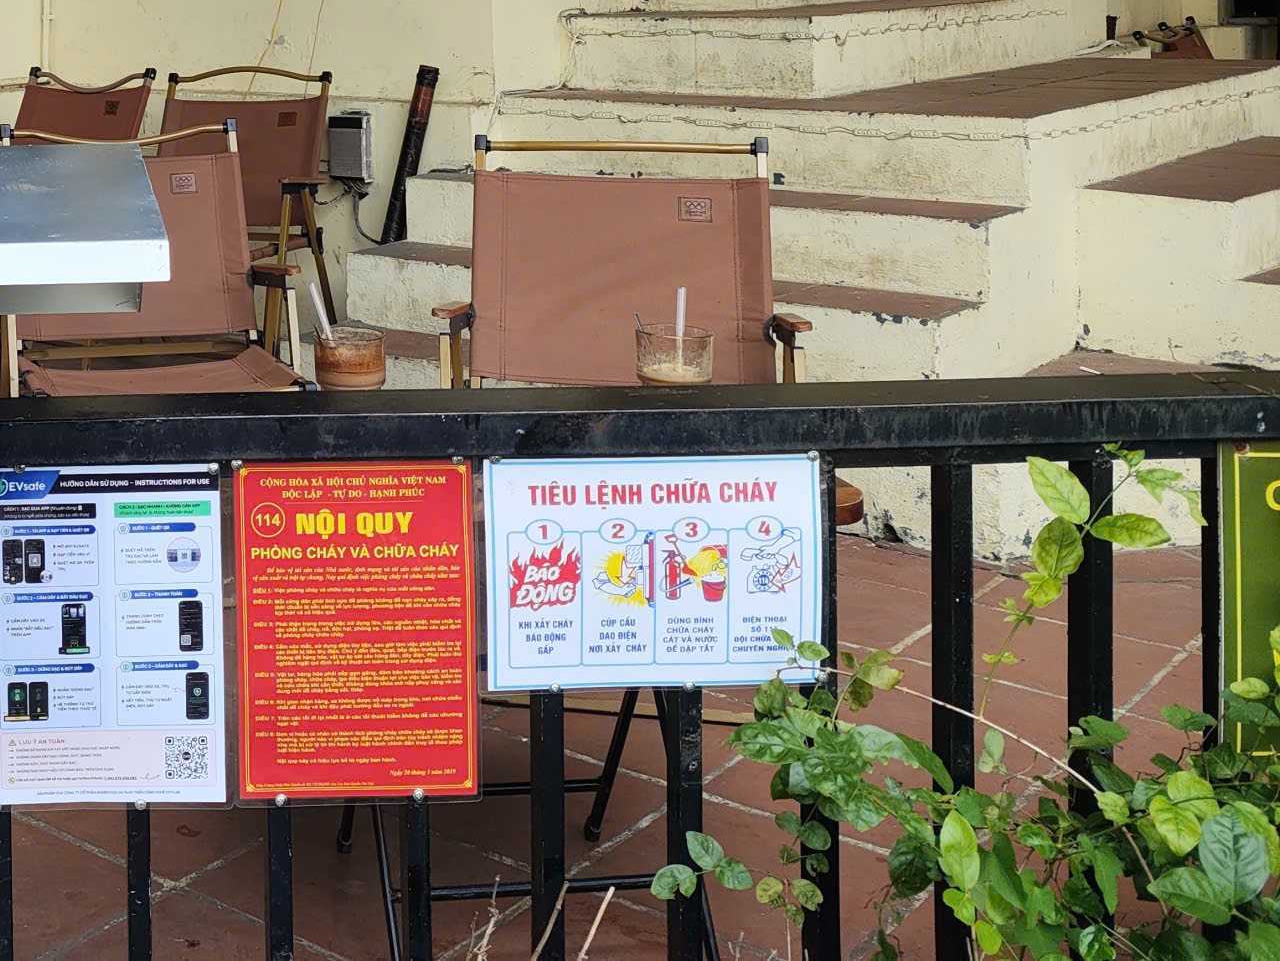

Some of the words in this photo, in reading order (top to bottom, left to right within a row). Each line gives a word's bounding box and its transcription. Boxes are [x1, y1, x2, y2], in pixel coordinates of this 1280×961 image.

[9, 481, 46, 492] EVsafe
[135, 479, 182, 487] INSTRUCTIONS
[260, 477, 287, 488] CỘNG
[289, 476, 309, 486] HÒA
[326, 476, 344, 487] HỘI
[346, 475, 365, 486] CHỦ
[369, 475, 398, 486] NGHĨA
[401, 475, 424, 487] VIỆT
[425, 475, 446, 485] NAM
[282, 489, 302, 499] ĐỘC
[304, 488, 322, 499] LẬP
[349, 489, 362, 498] DO
[370, 488, 397, 499] HẠNH
[399, 487, 425, 497] PHÚC
[528, 481, 577, 506] TIÊU
[585, 480, 643, 510] LỆNH
[650, 477, 711, 504] CHỮA
[719, 477, 778, 503] CHÁY
[255, 513, 281, 527] 114
[295, 508, 346, 539] NỘI
[356, 512, 413, 537] QUY
[539, 525, 548, 540] 1
[611, 523, 625, 539] 2
[685, 522, 698, 538] 3
[758, 520, 772, 536] 4
[251, 545, 302, 560] PHÒNG
[306, 544, 346, 559] CHÁY
[350, 544, 368, 558] VÀ
[374, 543, 417, 558] CHỮA
[420, 542, 459, 557] CHÁY
[524, 562, 560, 583] BÁO
[515, 581, 575, 609] ĐỘNG
[518, 620, 532, 629] KHI
[553, 619, 574, 628] CHÁY
[544, 632, 566, 643] ĐỘNG
[626, 643, 648, 653] CHÁY
